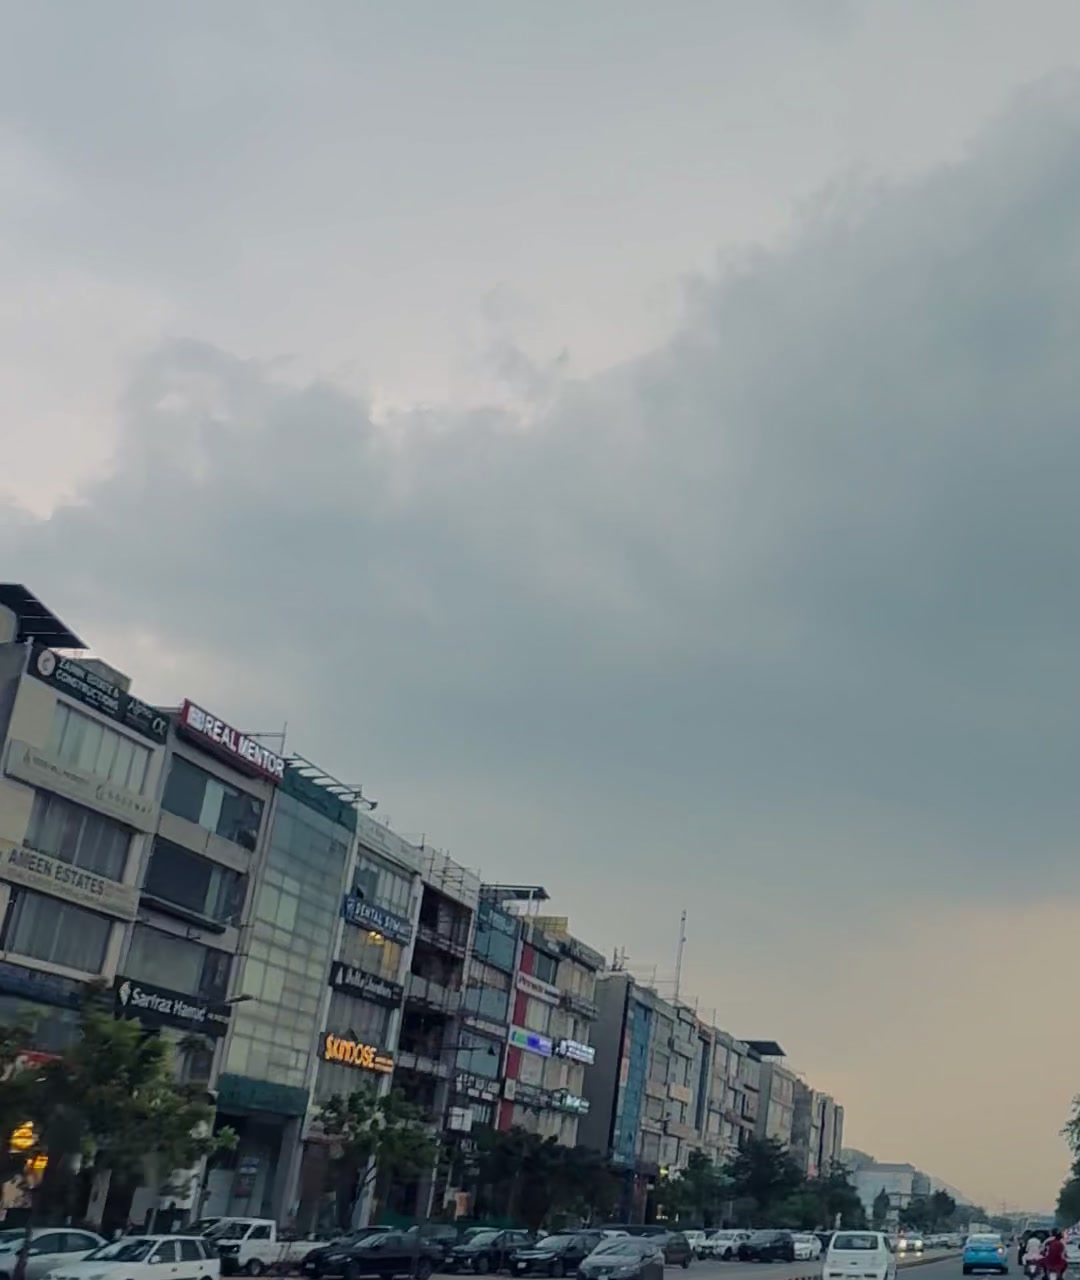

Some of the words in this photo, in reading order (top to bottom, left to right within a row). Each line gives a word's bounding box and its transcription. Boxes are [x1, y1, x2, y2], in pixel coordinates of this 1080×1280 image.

[203, 715, 237, 753] REAL
[238, 735, 284, 779] MENTOR
[55, 862, 105, 896] ESTATES
